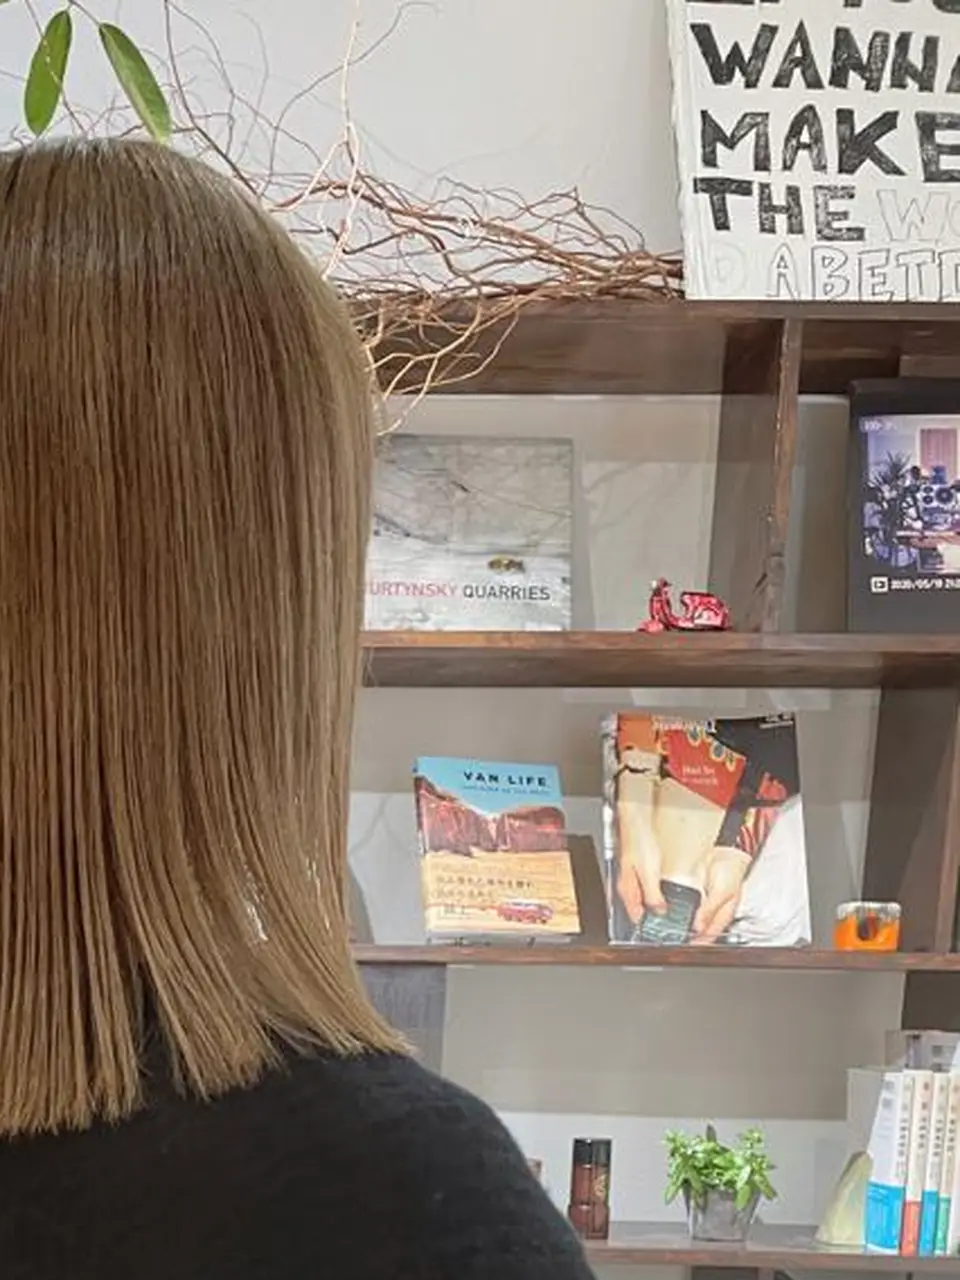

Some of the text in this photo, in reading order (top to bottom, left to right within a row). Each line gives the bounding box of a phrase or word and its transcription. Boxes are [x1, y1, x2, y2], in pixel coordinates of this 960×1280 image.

[700, 104, 960, 182] MAKE
[693, 177, 960, 243] THE W
[369, 581, 551, 601] URTYNSKY QUARRIES
[463, 771, 547, 788] VAN LIFE
